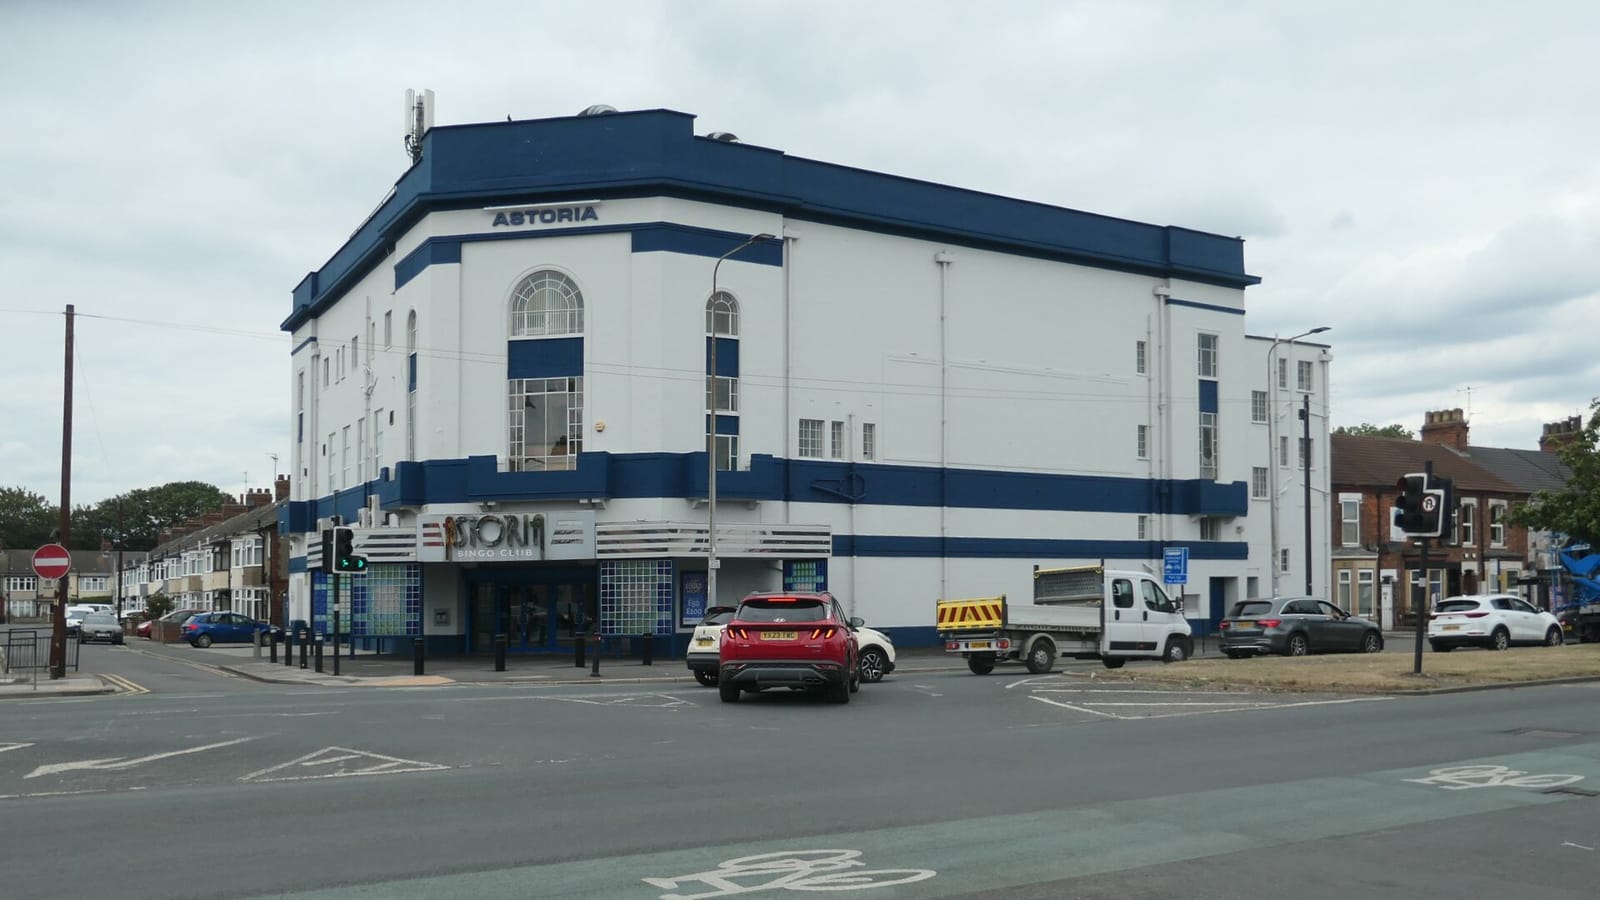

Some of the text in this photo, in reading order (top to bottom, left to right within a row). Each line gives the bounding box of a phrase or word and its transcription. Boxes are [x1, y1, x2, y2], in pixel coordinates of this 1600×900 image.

[492, 206, 599, 227] ASTORIA
[457, 548, 534, 558] BINGO CLUB
